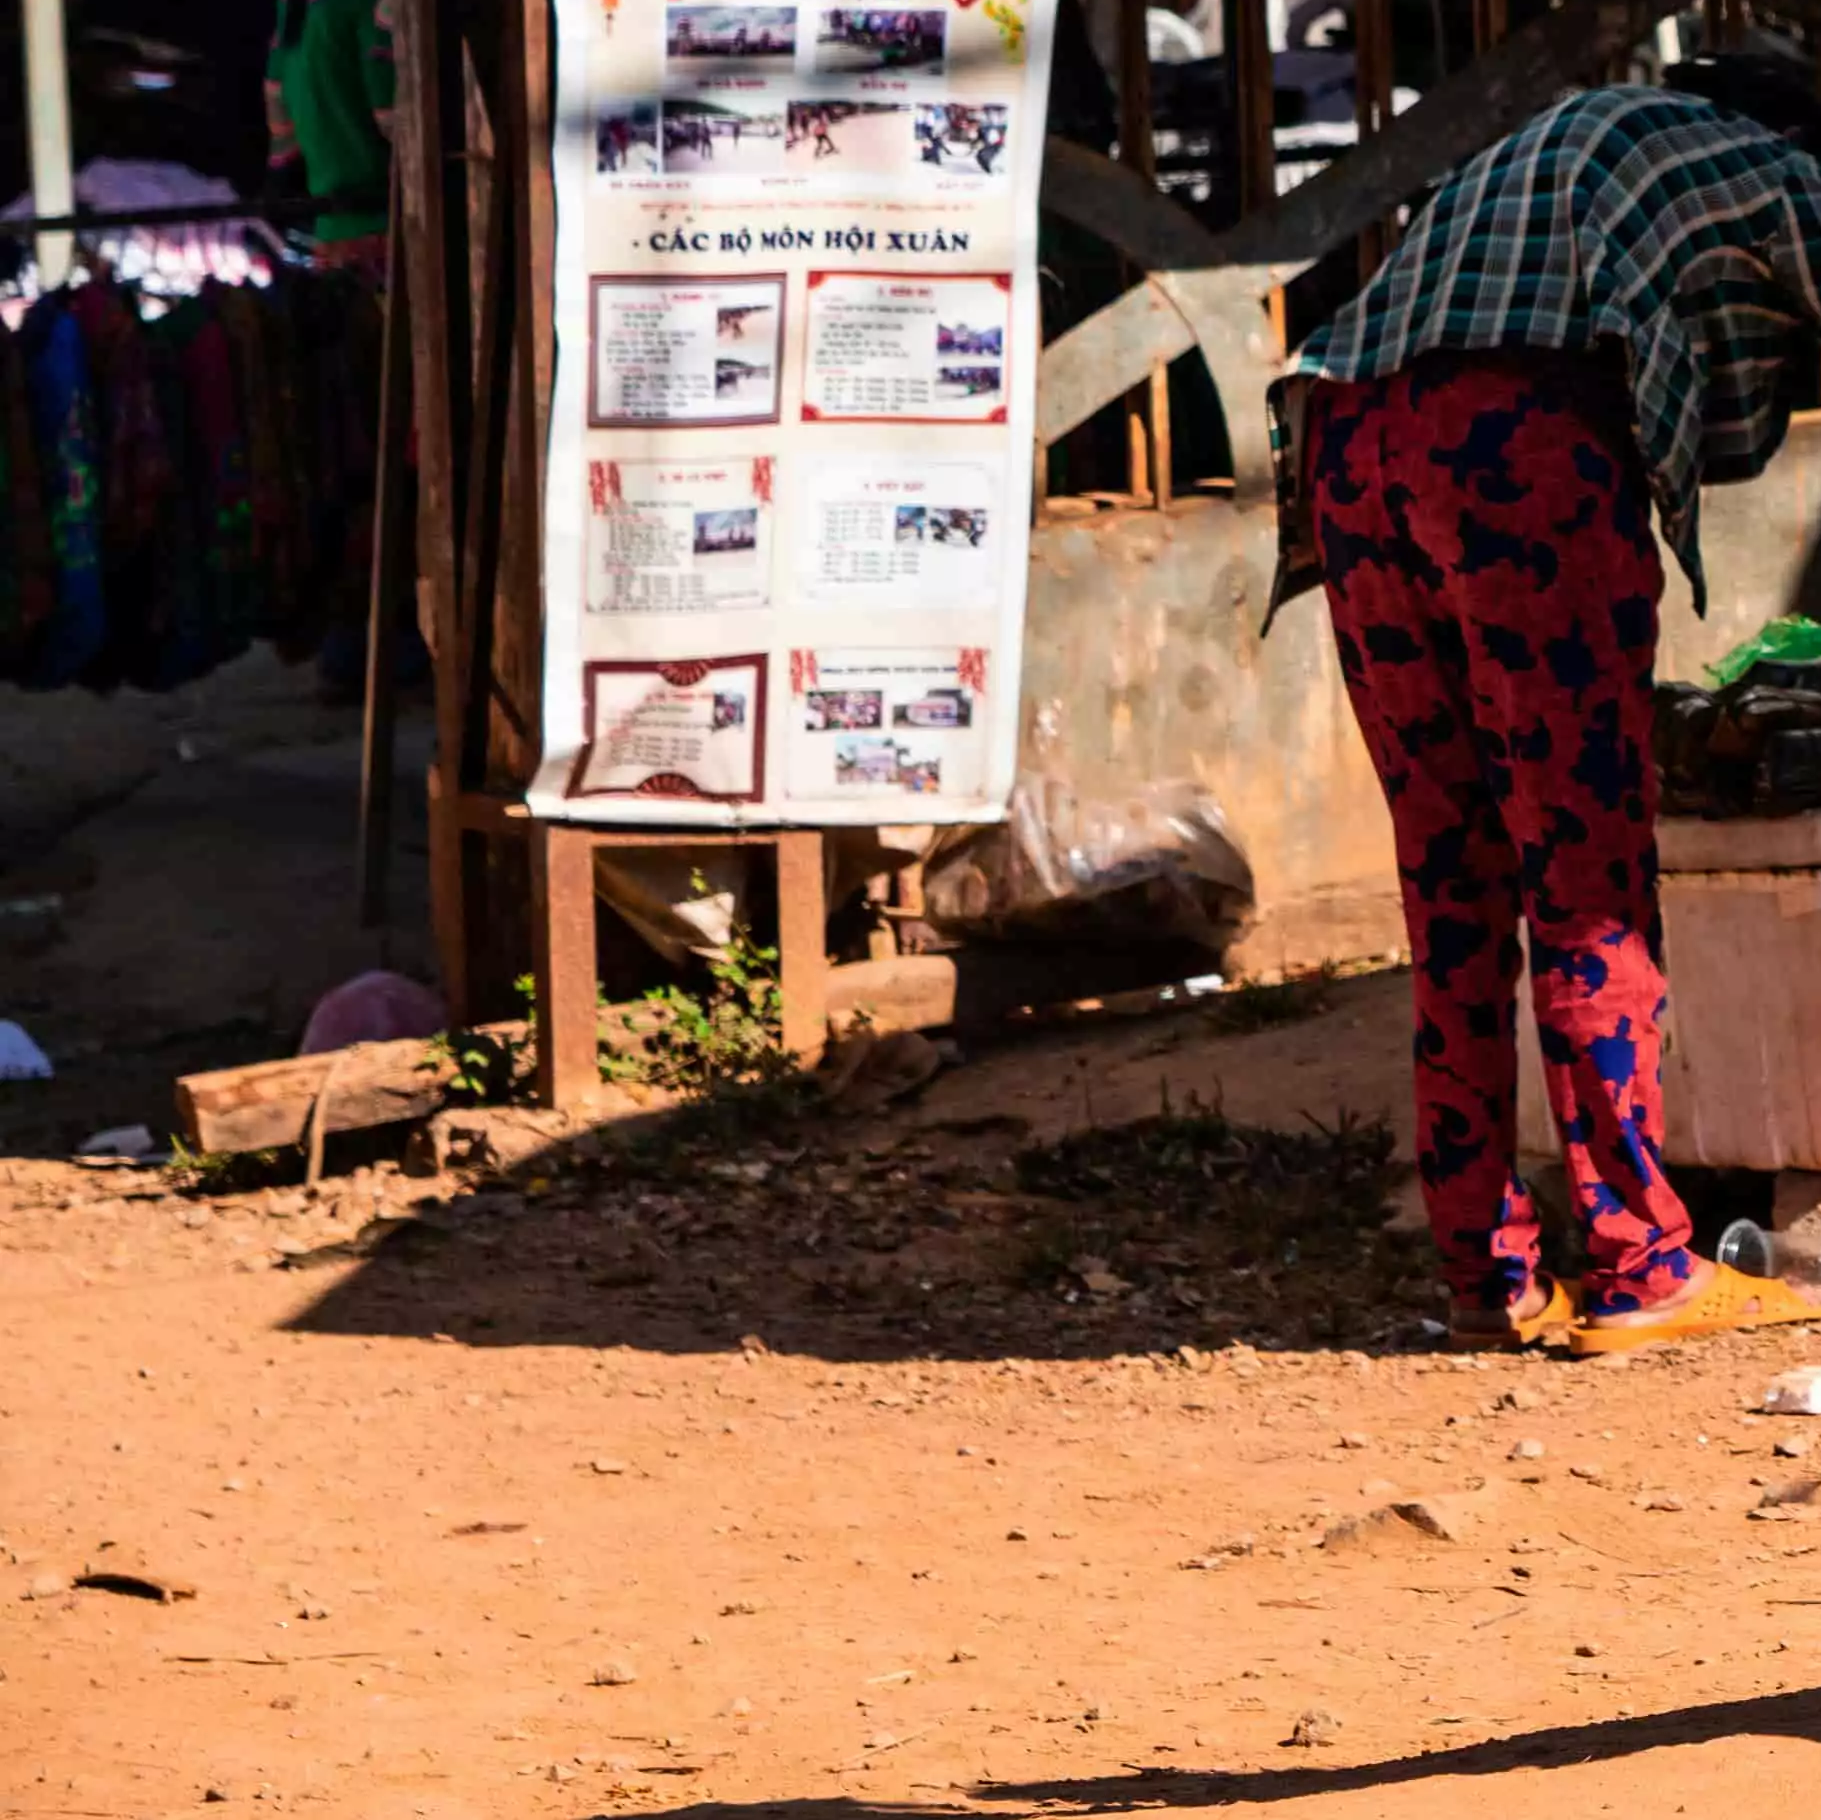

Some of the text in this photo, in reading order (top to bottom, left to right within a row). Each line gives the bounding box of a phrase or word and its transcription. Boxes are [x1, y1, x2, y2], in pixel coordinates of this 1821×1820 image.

[648, 225, 971, 258] CÁC BỘ MÔN HỘI XUÂN
